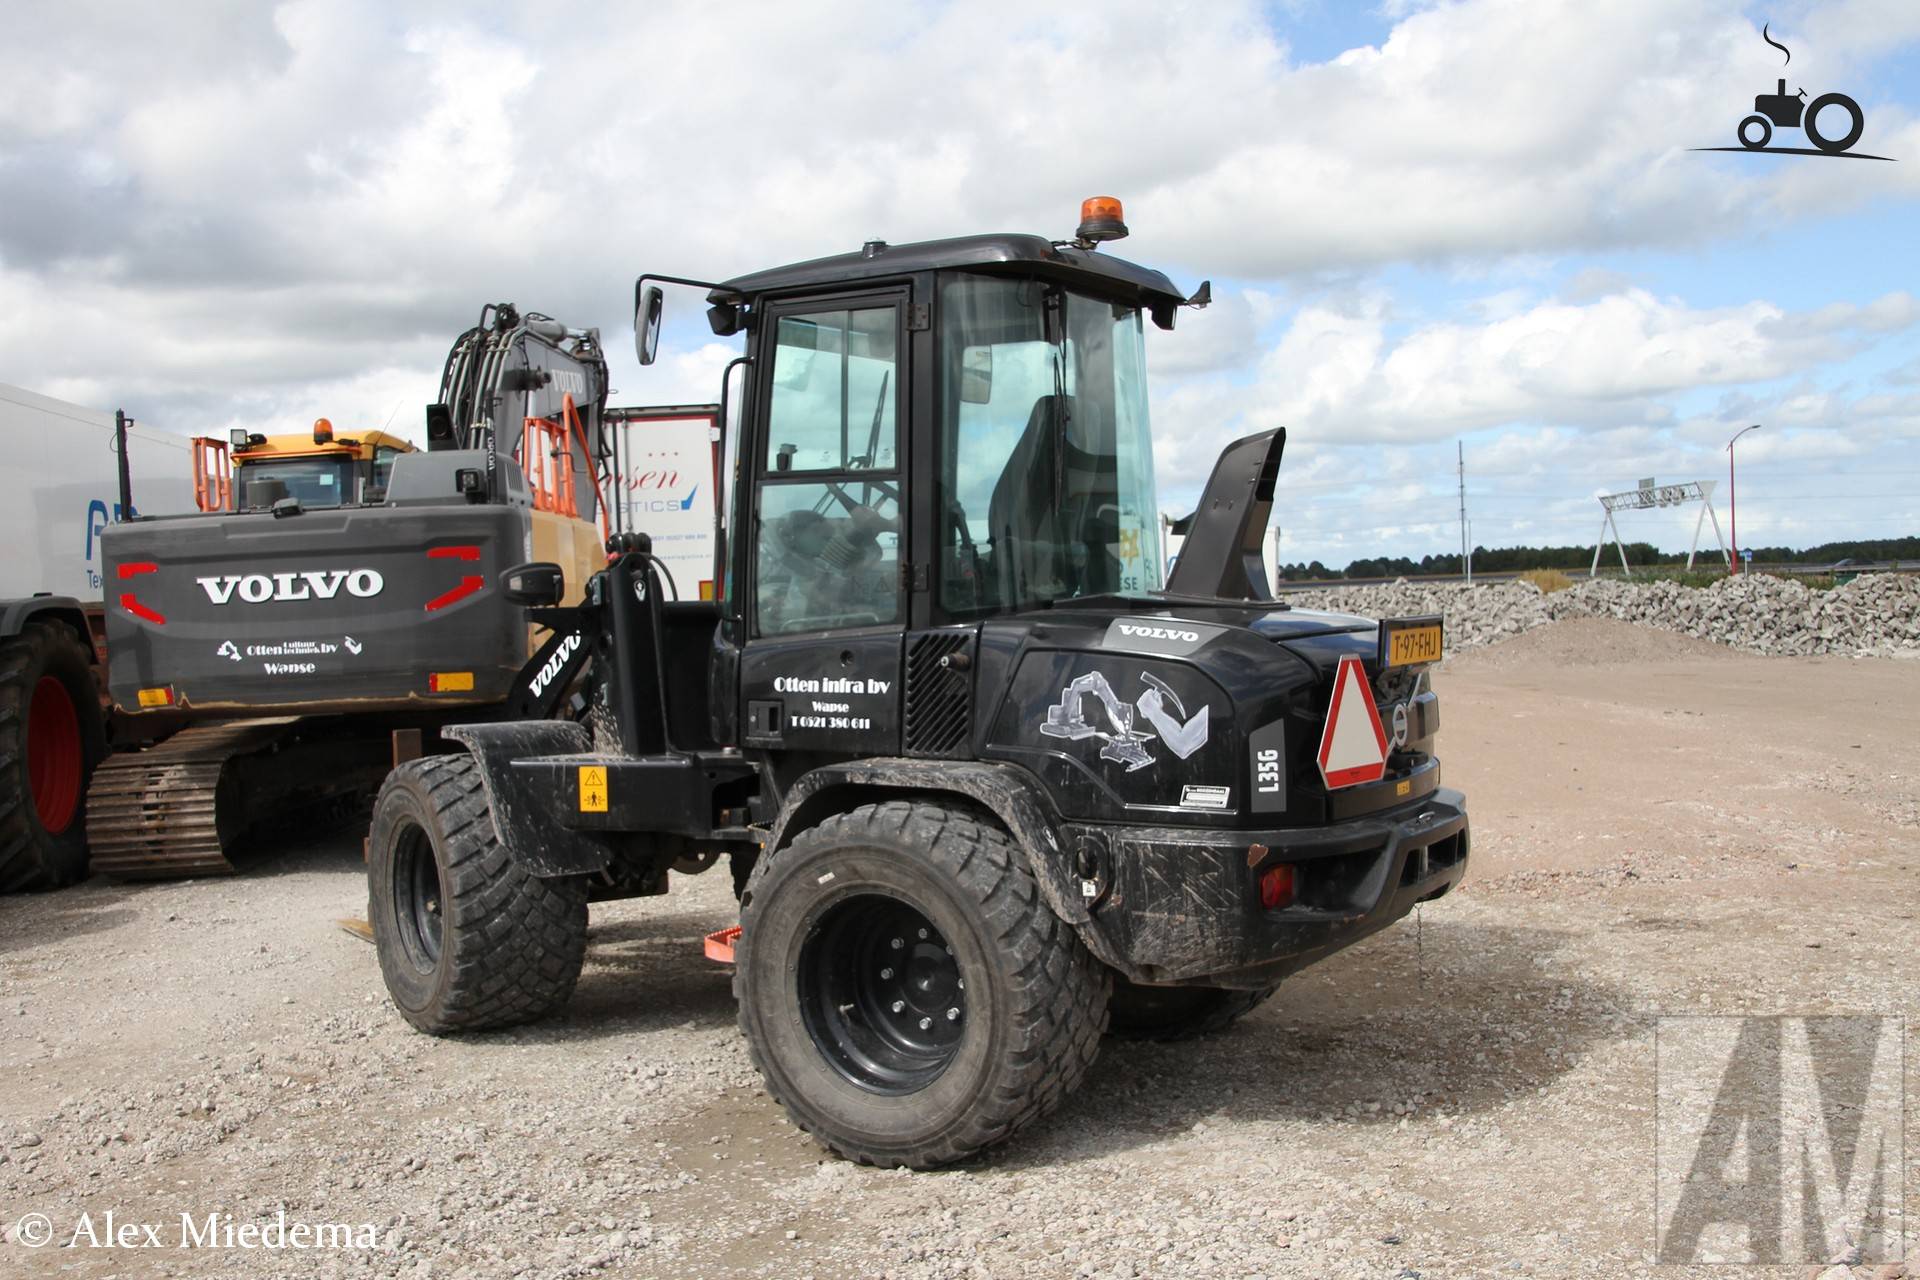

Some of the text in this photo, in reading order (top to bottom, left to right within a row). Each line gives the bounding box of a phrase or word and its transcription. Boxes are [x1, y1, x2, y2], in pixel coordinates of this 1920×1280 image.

[551, 369, 584, 395] VOLVO
[197, 569, 384, 604] VOLVO
[1118, 624, 1199, 642] VOLVO
[246, 643, 339, 656] Otten bv
[528, 629, 581, 698] VOLVO
[773, 676, 891, 695] Otten infra bv
[811, 700, 850, 713] Wapse
[791, 715, 871, 730] T 0521 380 611
[1257, 749, 1279, 793] L35G
